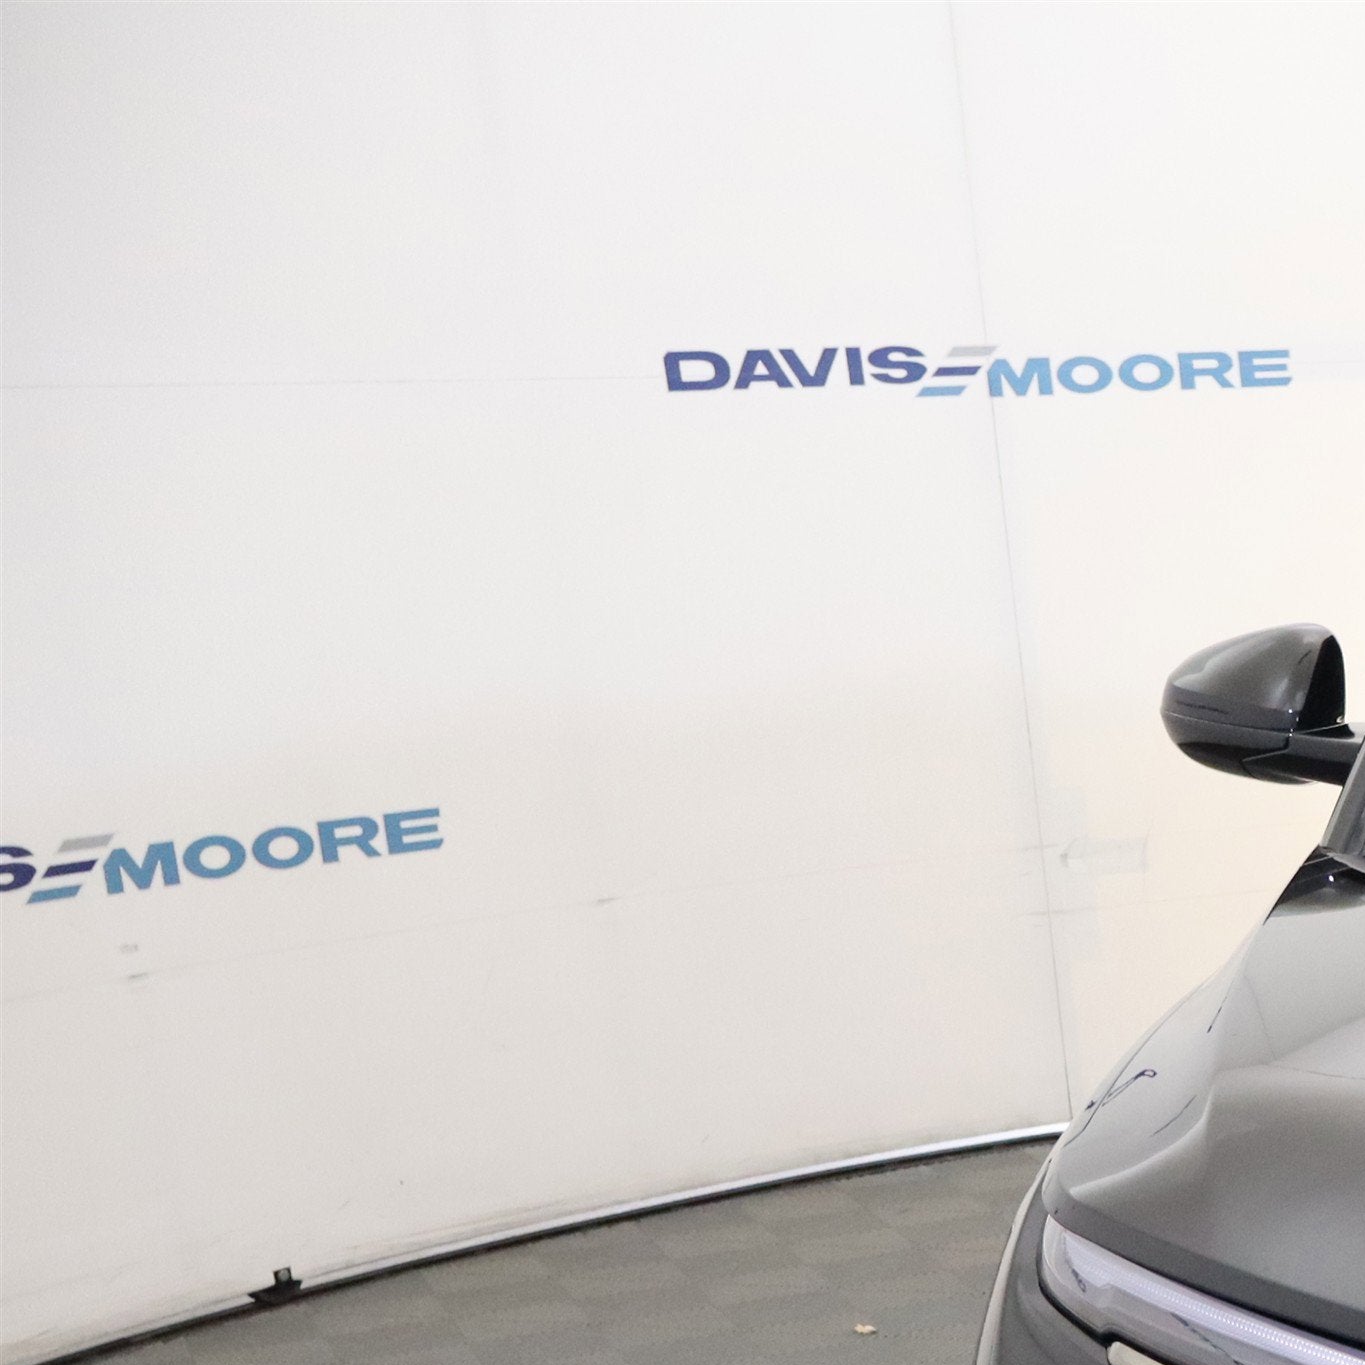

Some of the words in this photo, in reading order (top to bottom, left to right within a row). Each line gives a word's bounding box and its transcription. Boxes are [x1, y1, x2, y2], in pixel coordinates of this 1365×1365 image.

[663, 346, 927, 391] DAVIS
[987, 349, 1294, 397] MOORE
[102, 808, 444, 895] MOORE
